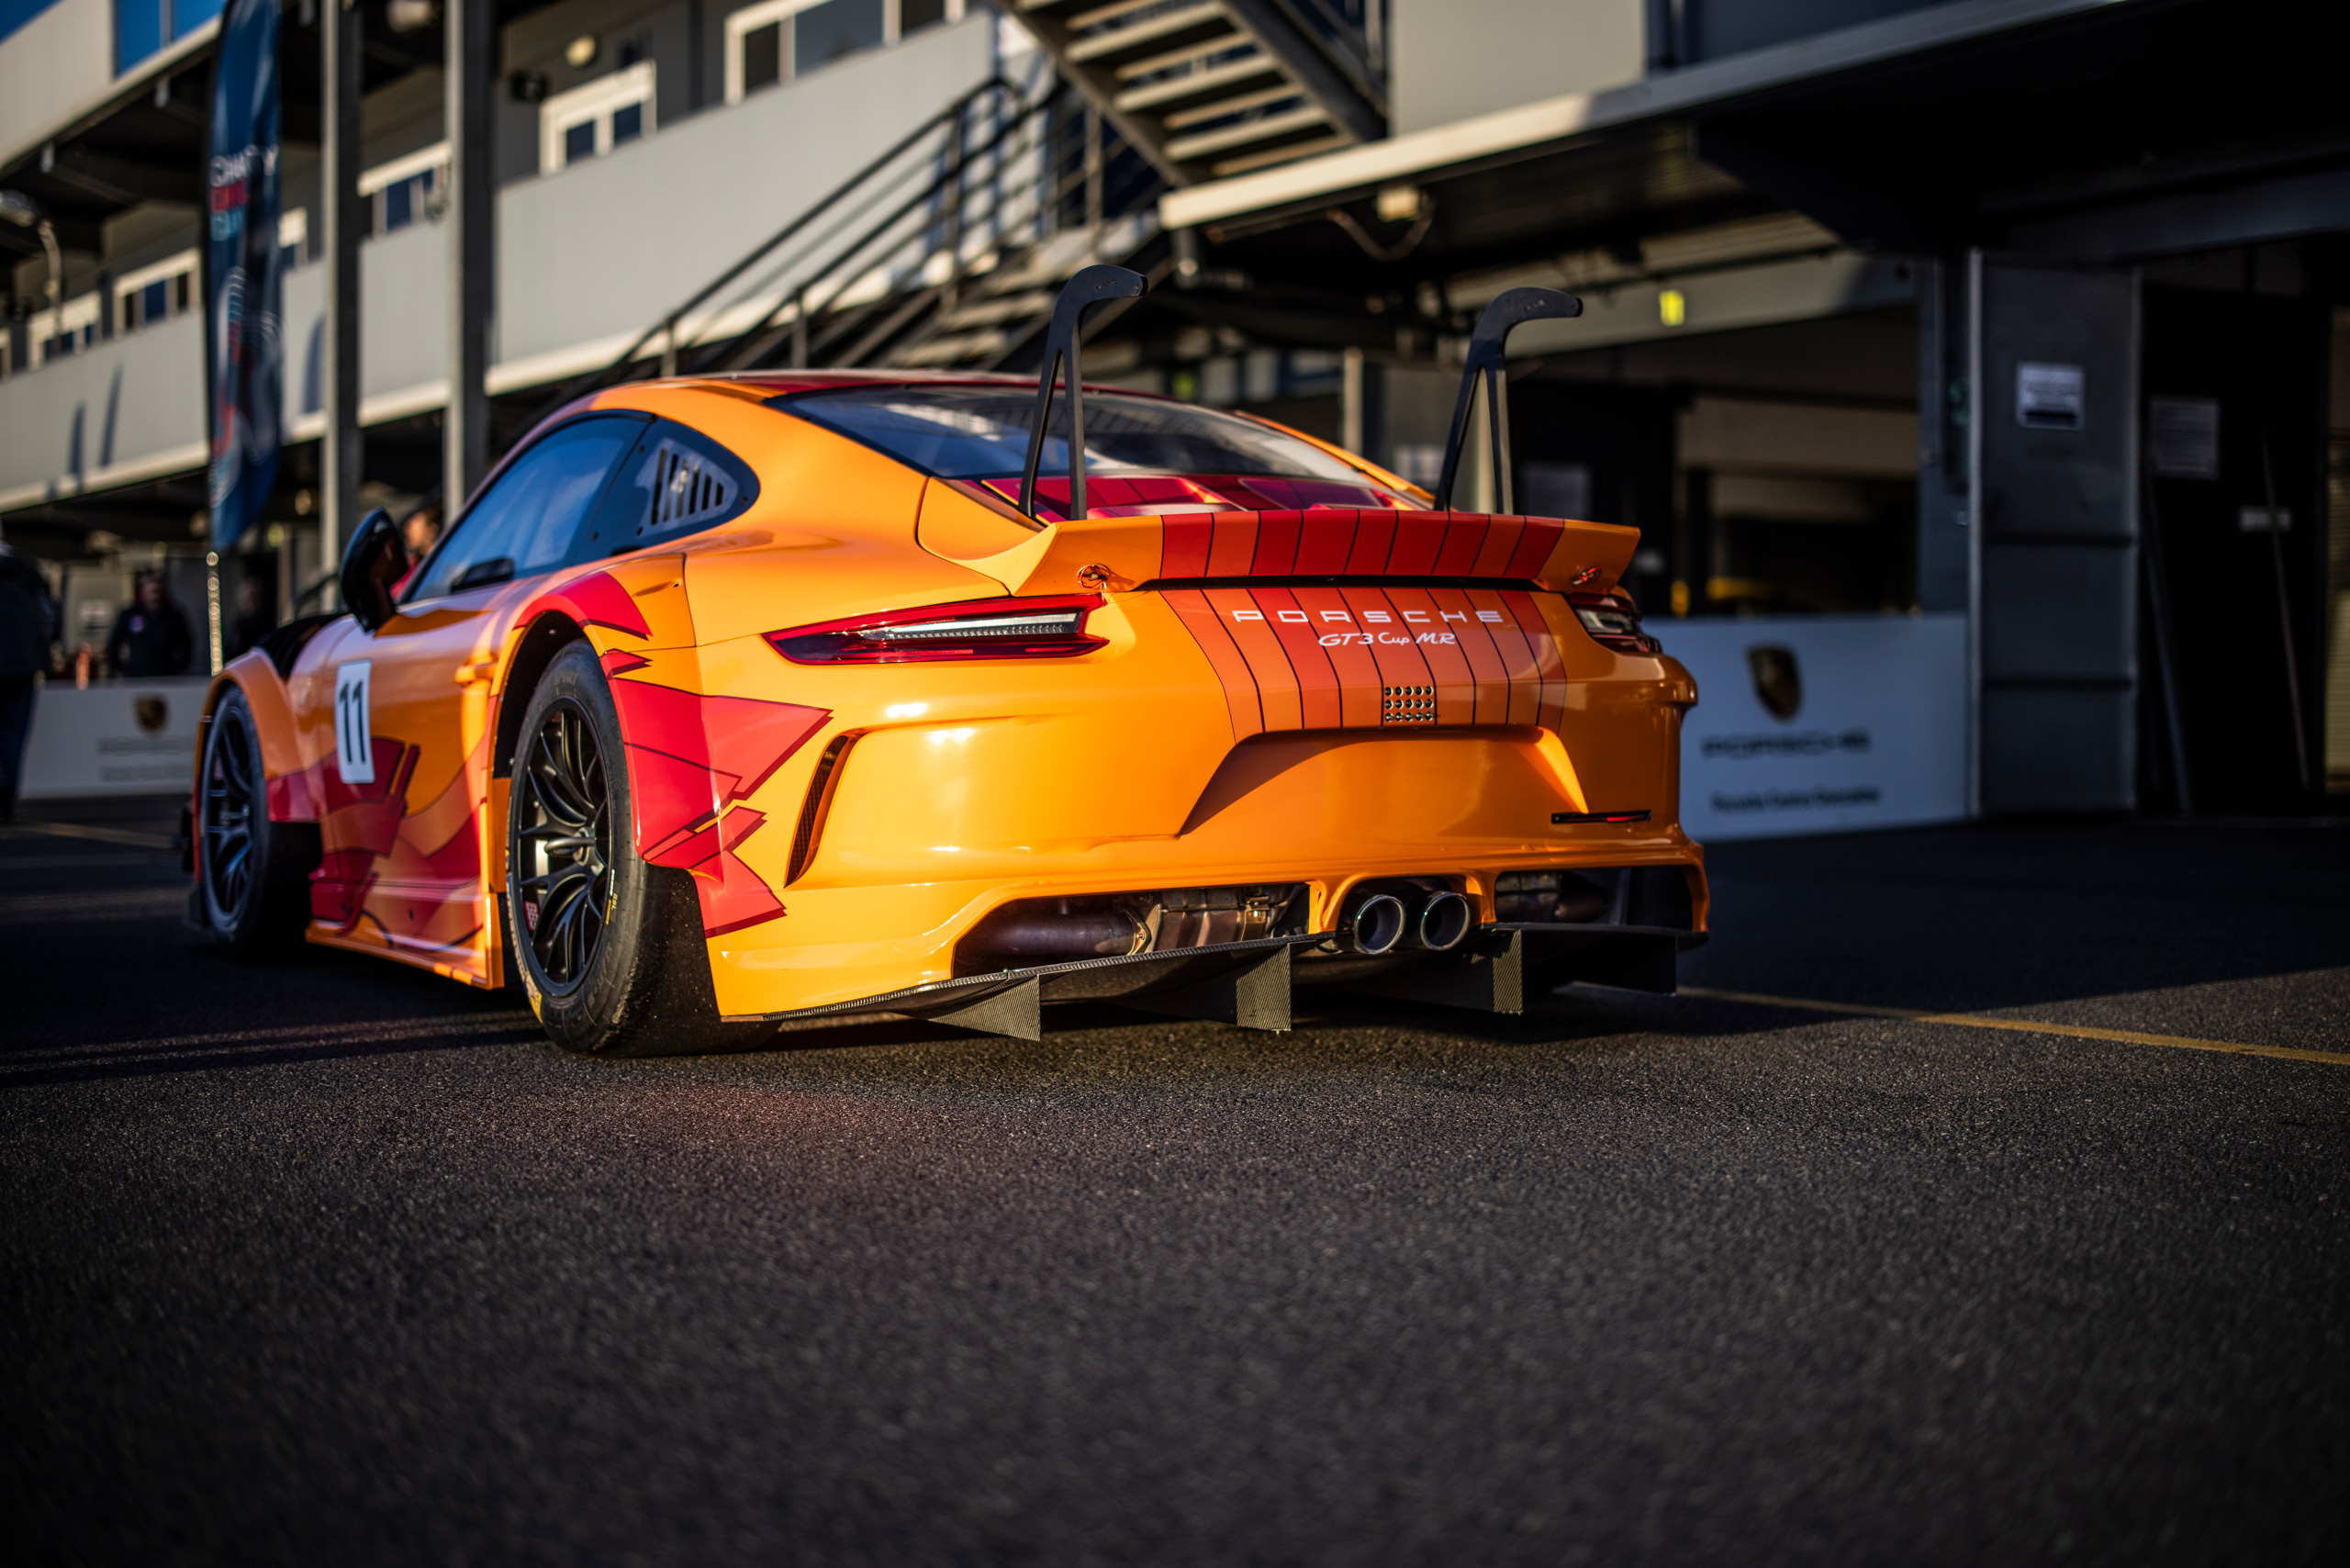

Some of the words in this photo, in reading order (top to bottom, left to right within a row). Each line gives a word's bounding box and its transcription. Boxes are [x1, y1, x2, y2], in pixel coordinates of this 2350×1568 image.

[1232, 610, 1504, 622] PORSCHE
[1318, 633, 1373, 646] GT3
[1378, 632, 1410, 645] Cup
[1416, 633, 1455, 644] MR
[339, 680, 365, 764] 11
